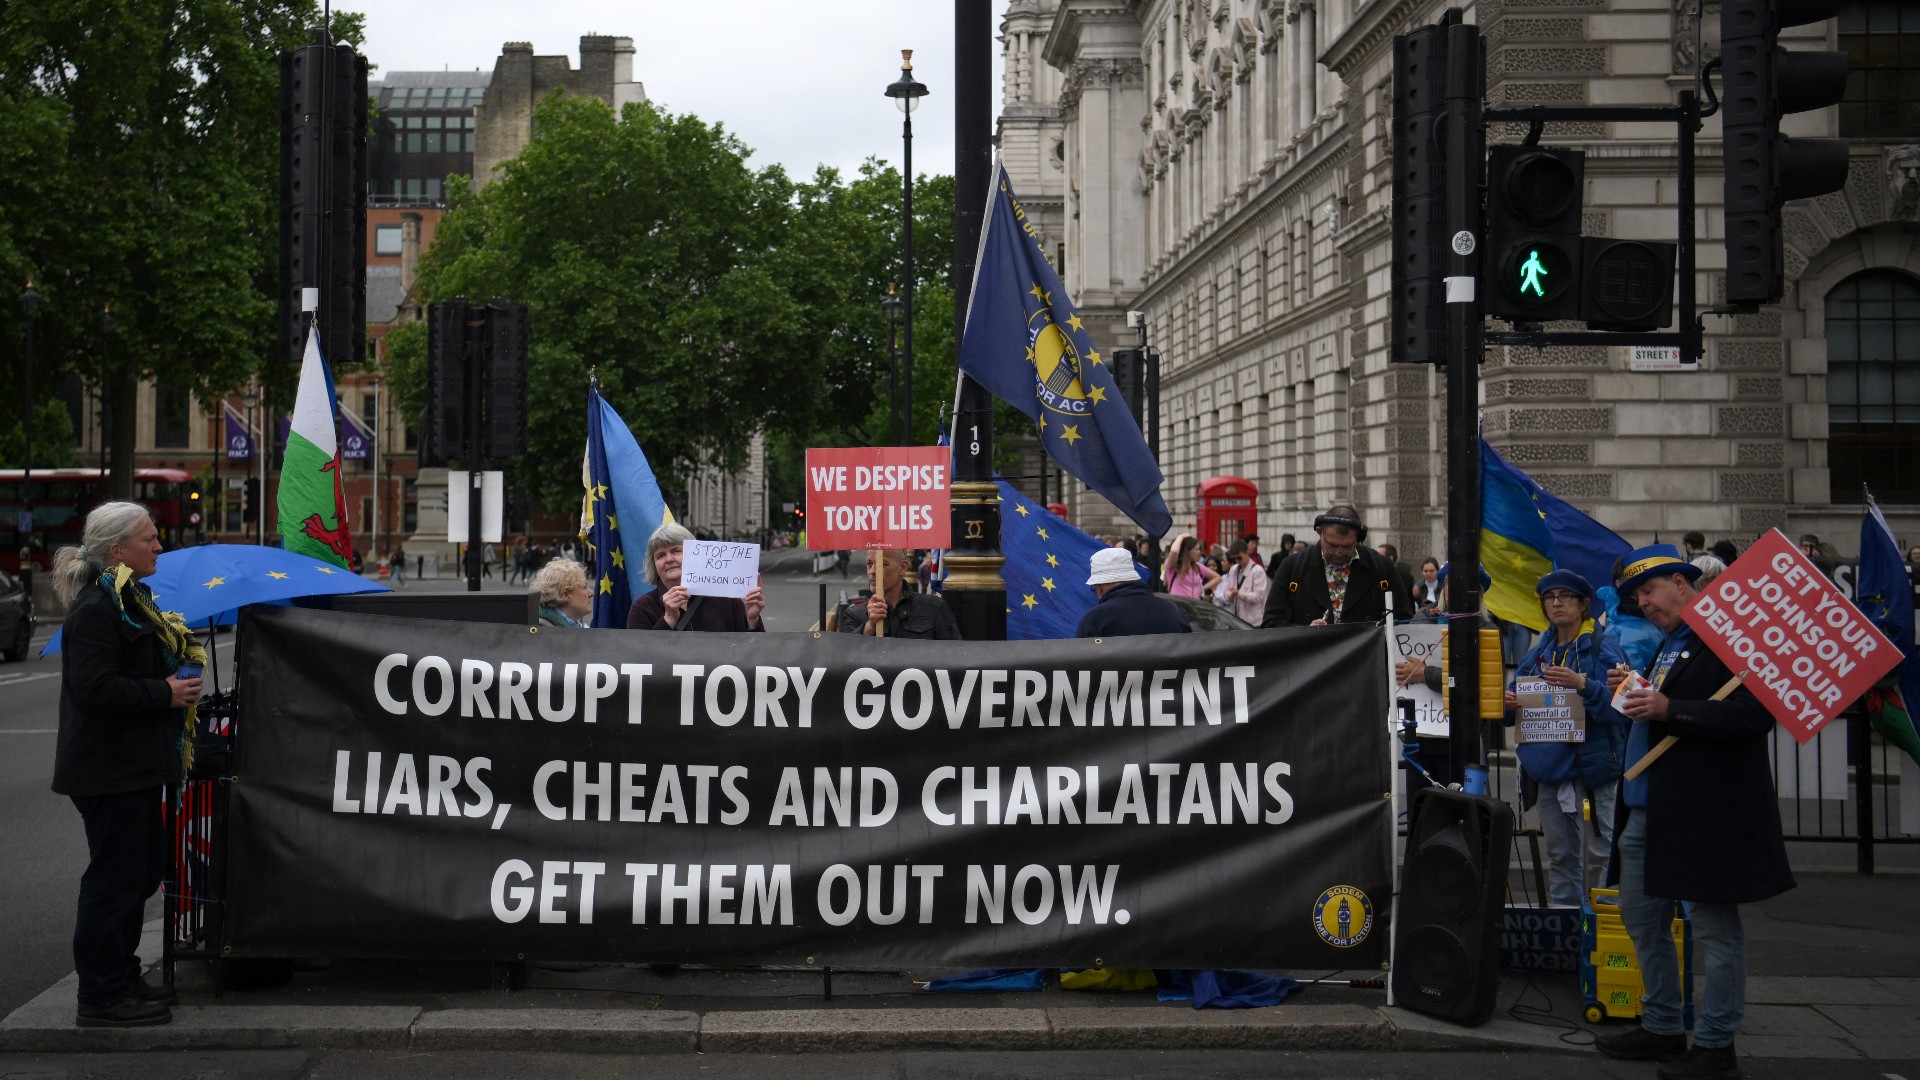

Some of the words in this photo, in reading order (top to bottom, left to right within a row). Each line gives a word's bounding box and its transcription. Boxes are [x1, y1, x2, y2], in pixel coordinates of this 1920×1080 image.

[1635, 350, 1669, 359] STREET
[1672, 350, 1680, 359] S
[1058, 400, 1088, 412] AC
[811, 466, 847, 492] WE
[855, 465, 945, 491] DESPISE
[823, 505, 882, 531] TORY
[889, 504, 934, 531] LIES
[692, 543, 728, 558] STOP
[730, 545, 753, 559] THE
[705, 558, 732, 570] ROT
[686, 572, 729, 585] JOHNSON
[732, 576, 753, 586] OUT
[1772, 552, 1821, 596] GET
[1814, 591, 1877, 659] YOUR
[1748, 574, 1857, 679] JOHNSON
[1719, 581, 1770, 628] OUT
[1762, 626, 1799, 656] OF
[1791, 656, 1842, 709] OUR
[1693, 595, 1825, 730] DEMOCRACY!
[374, 653, 653, 724] CORRUPT
[673, 664, 827, 727] TORY
[844, 666, 1255, 730] GOVERNMENT
[1518, 684, 1532, 692] Sue
[1533, 682, 1551, 692] Gray
[1556, 695, 1565, 704] ??
[1523, 708, 1559, 718] Downfall
[1560, 708, 1570, 717] of
[1521, 721, 1551, 731] corrupt
[1554, 720, 1573, 731] Tory
[1522, 732, 1568, 741] government
[1574, 730, 1583, 740] ??
[333, 750, 511, 829] LIARS,
[533, 760, 749, 825] CHEATS
[769, 767, 898, 827] AND
[922, 762, 1293, 826] CHARLATANS
[491, 859, 605, 924] GET
[625, 863, 793, 925] THEM
[818, 864, 943, 926] OUT
[965, 864, 1130, 925] NOW.
[1327, 887, 1363, 900] SODEM
[1315, 915, 1329, 938] TIME
[1328, 935, 1347, 946] FOR
[1350, 914, 1372, 945] ACTION
[1503, 914, 1562, 932] DON
[1551, 934, 1580, 952] OT
[1510, 951, 1577, 971] REXIT
